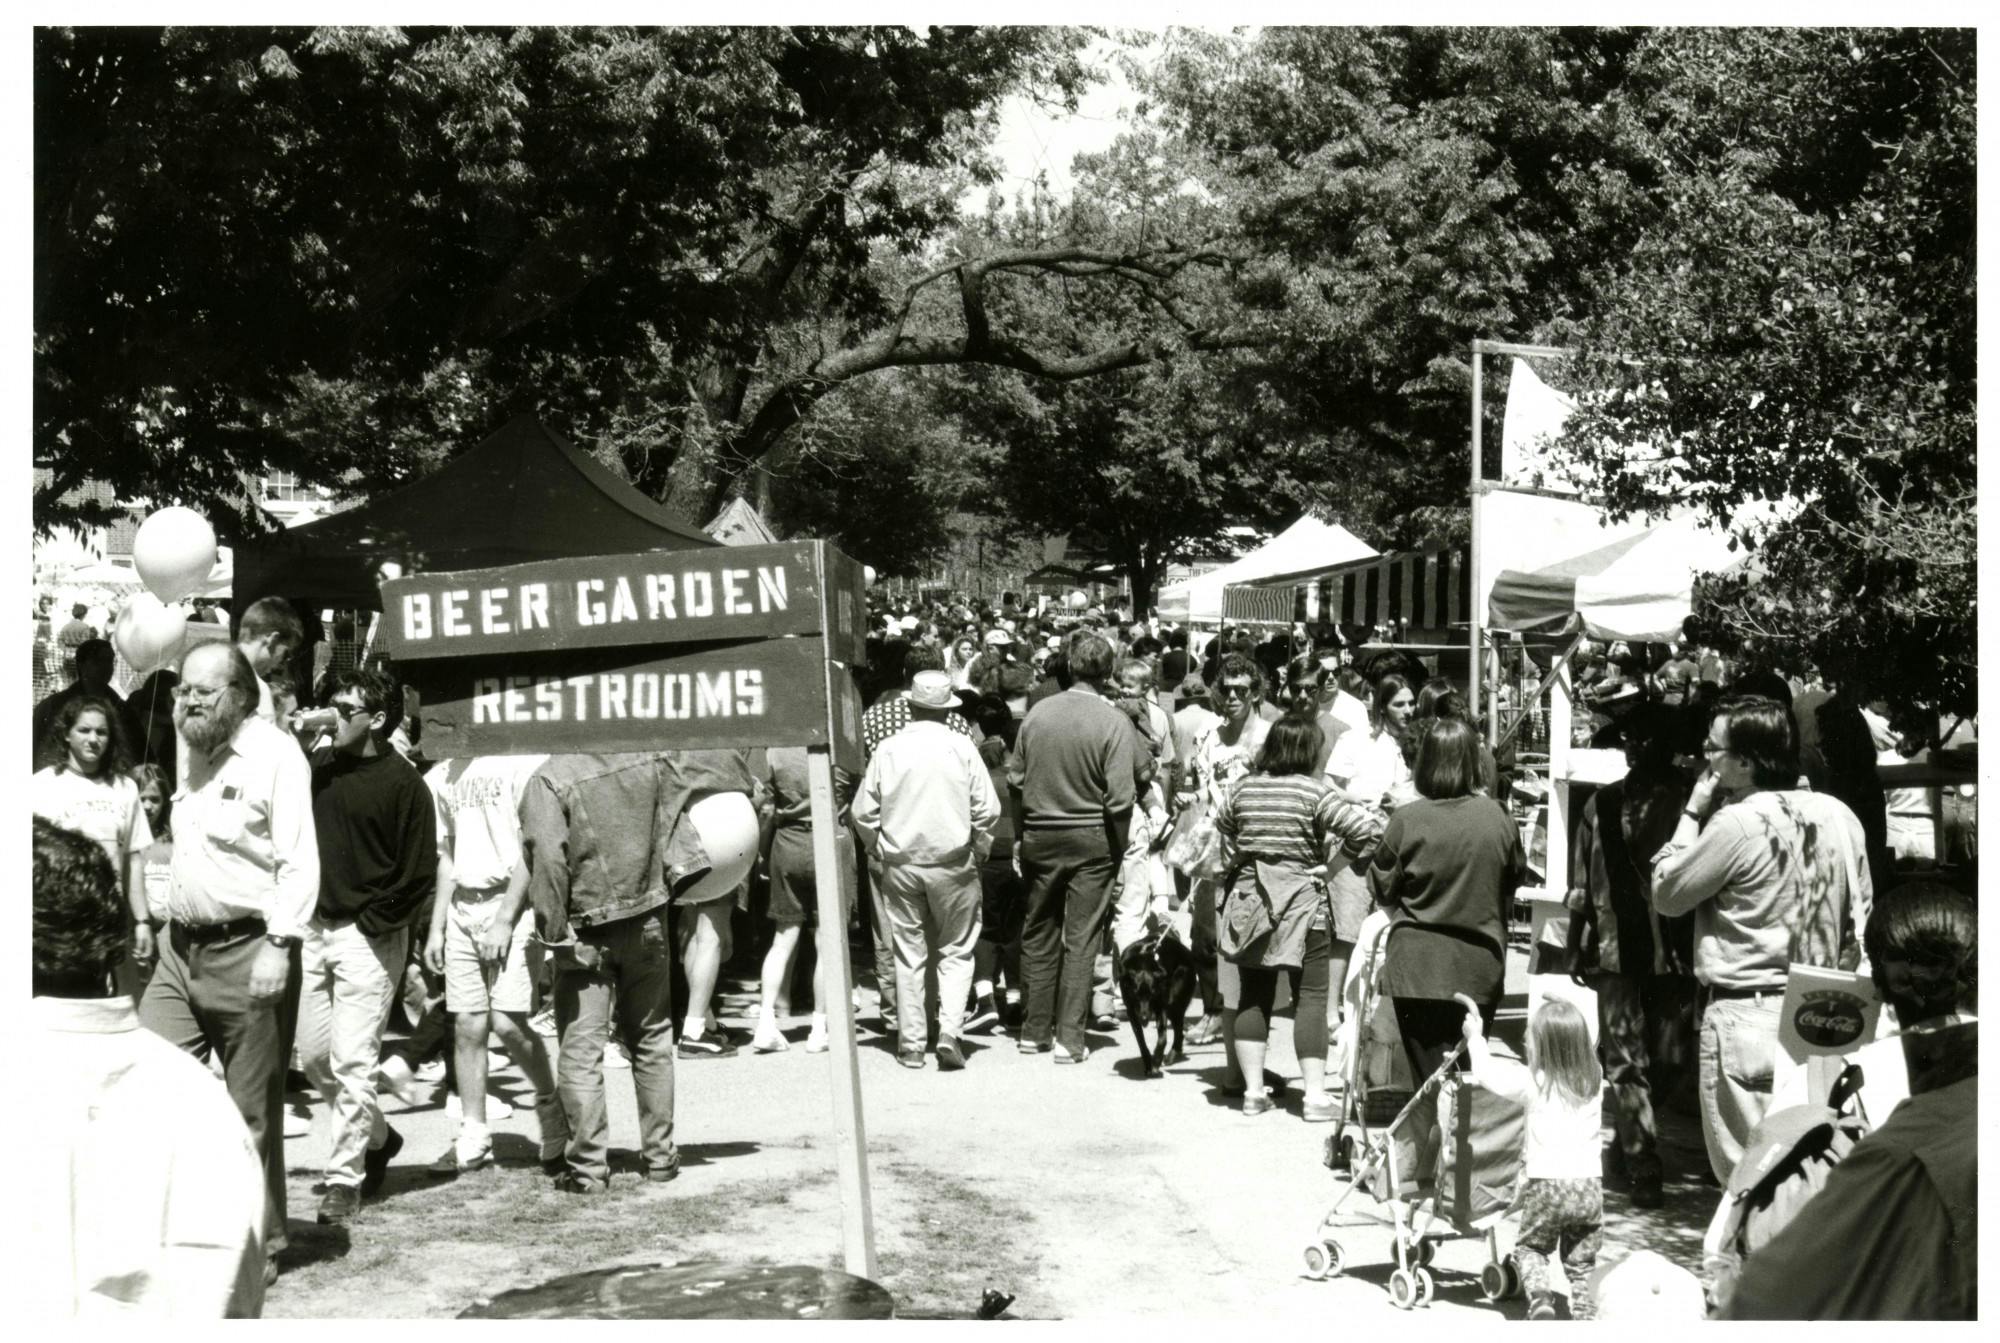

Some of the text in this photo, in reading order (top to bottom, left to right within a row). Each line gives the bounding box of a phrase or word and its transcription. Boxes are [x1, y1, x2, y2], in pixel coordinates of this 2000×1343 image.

[402, 565, 788, 640] BEER GARDEN
[473, 669, 765, 724] RESTROOMS
